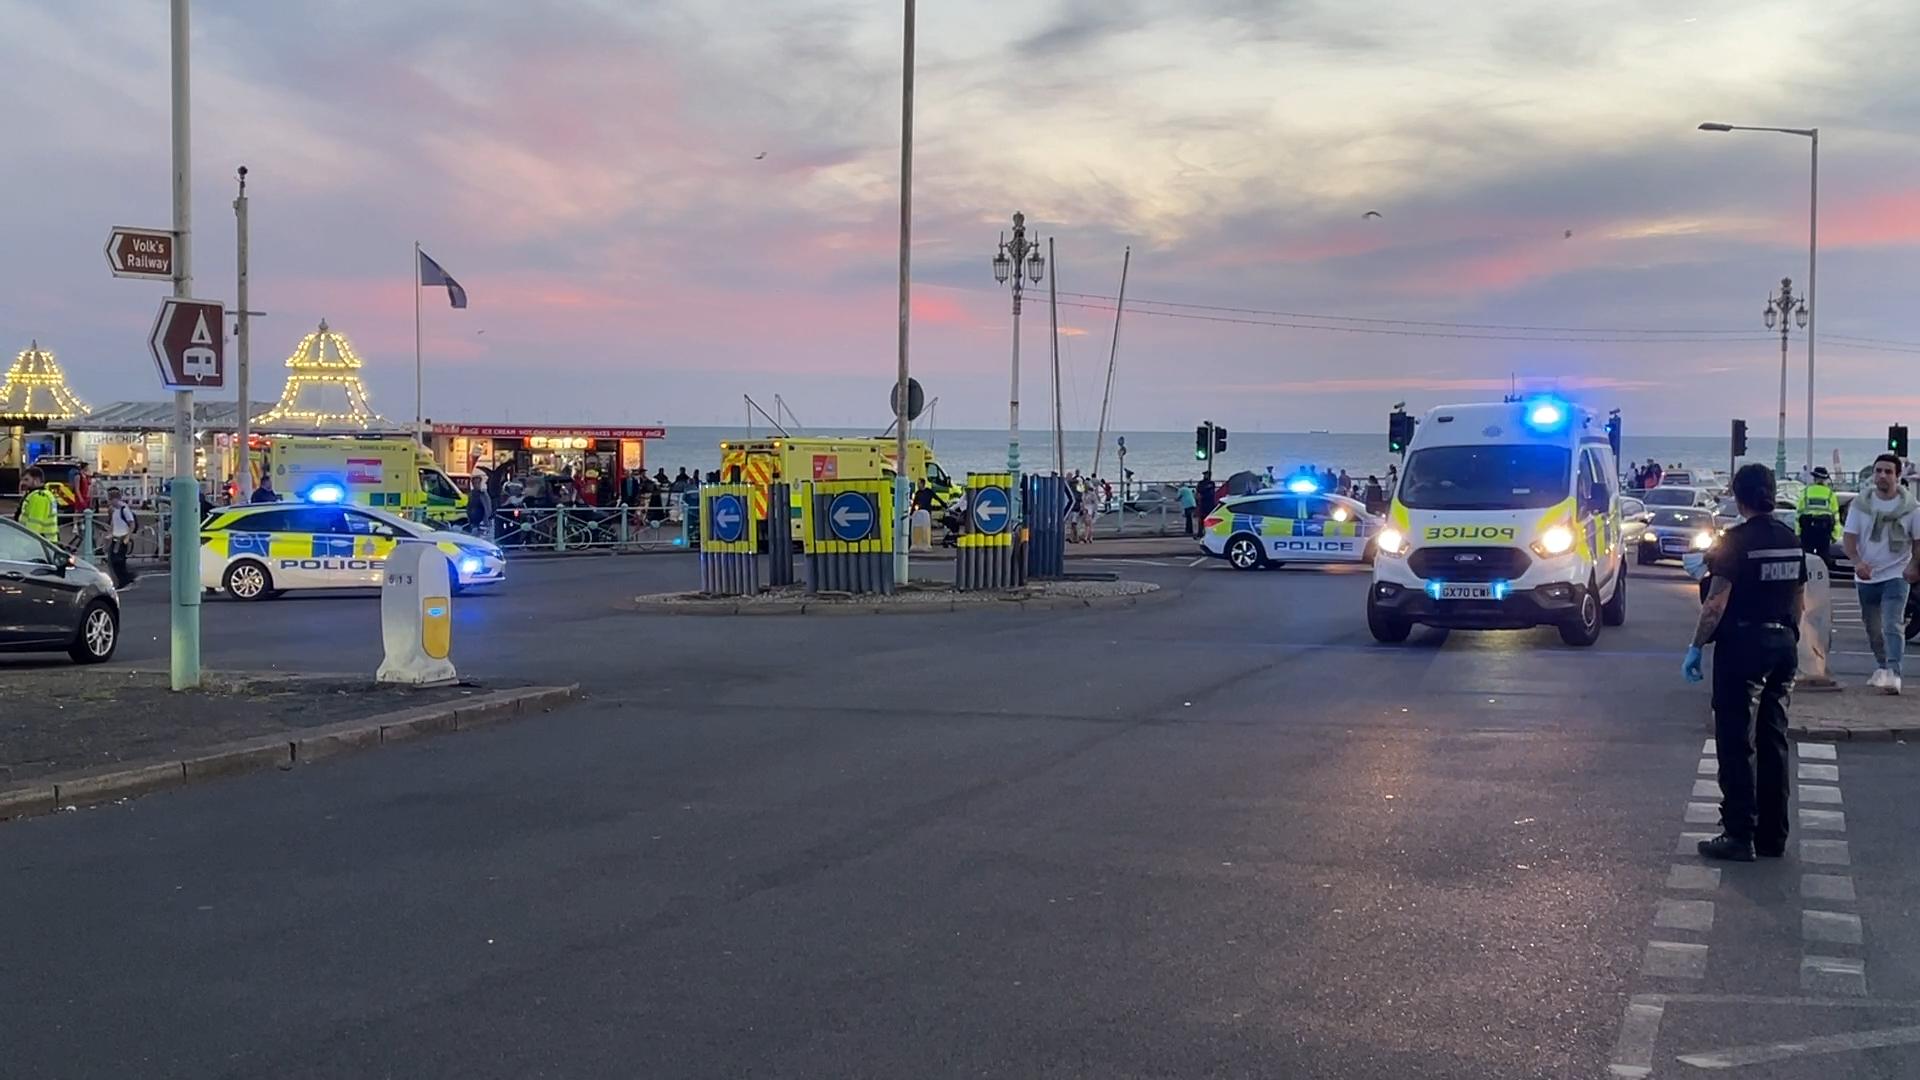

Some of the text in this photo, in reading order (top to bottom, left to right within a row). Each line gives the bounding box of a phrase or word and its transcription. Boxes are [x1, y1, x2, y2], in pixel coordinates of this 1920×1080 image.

[132, 238, 165, 254] Volk's
[127, 253, 169, 271] Railway
[1273, 541, 1354, 552] POLICE
[280, 559, 384, 570] POLICE
